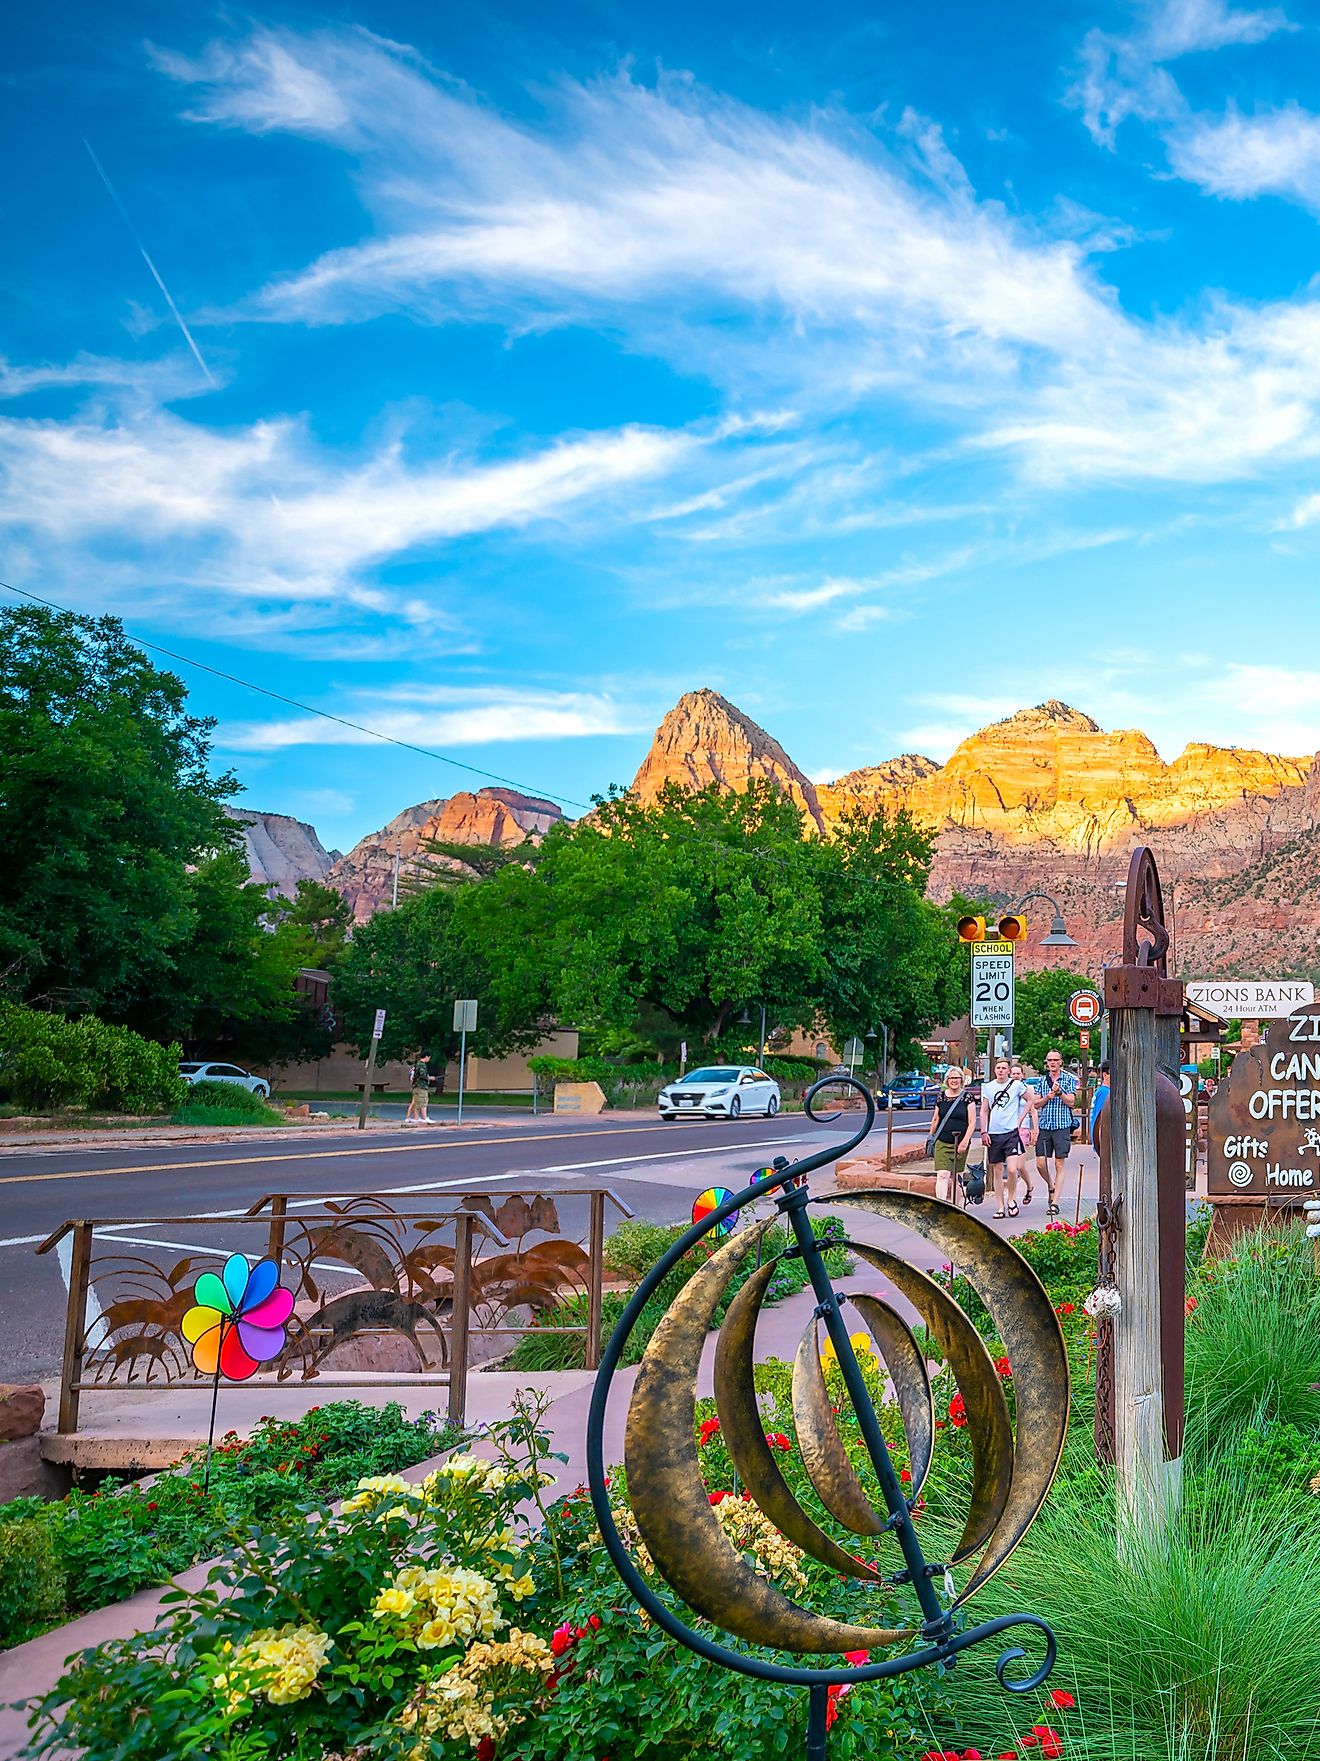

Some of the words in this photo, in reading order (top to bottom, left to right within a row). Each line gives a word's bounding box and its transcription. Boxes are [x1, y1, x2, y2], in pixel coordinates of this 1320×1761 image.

[974, 943, 1011, 953] SCHOOL
[975, 961, 1011, 969] SPEED
[979, 972, 1006, 980] LIMIT
[976, 982, 1009, 1001] 20
[1192, 988, 1249, 1001] ZIONS
[1255, 987, 1306, 1000] BANK
[1257, 1004, 1277, 1012] ATM
[1081, 1036, 1088, 1045] 5
[1223, 1135, 1269, 1158] Gifts
[1265, 1162, 1313, 1186] Home
